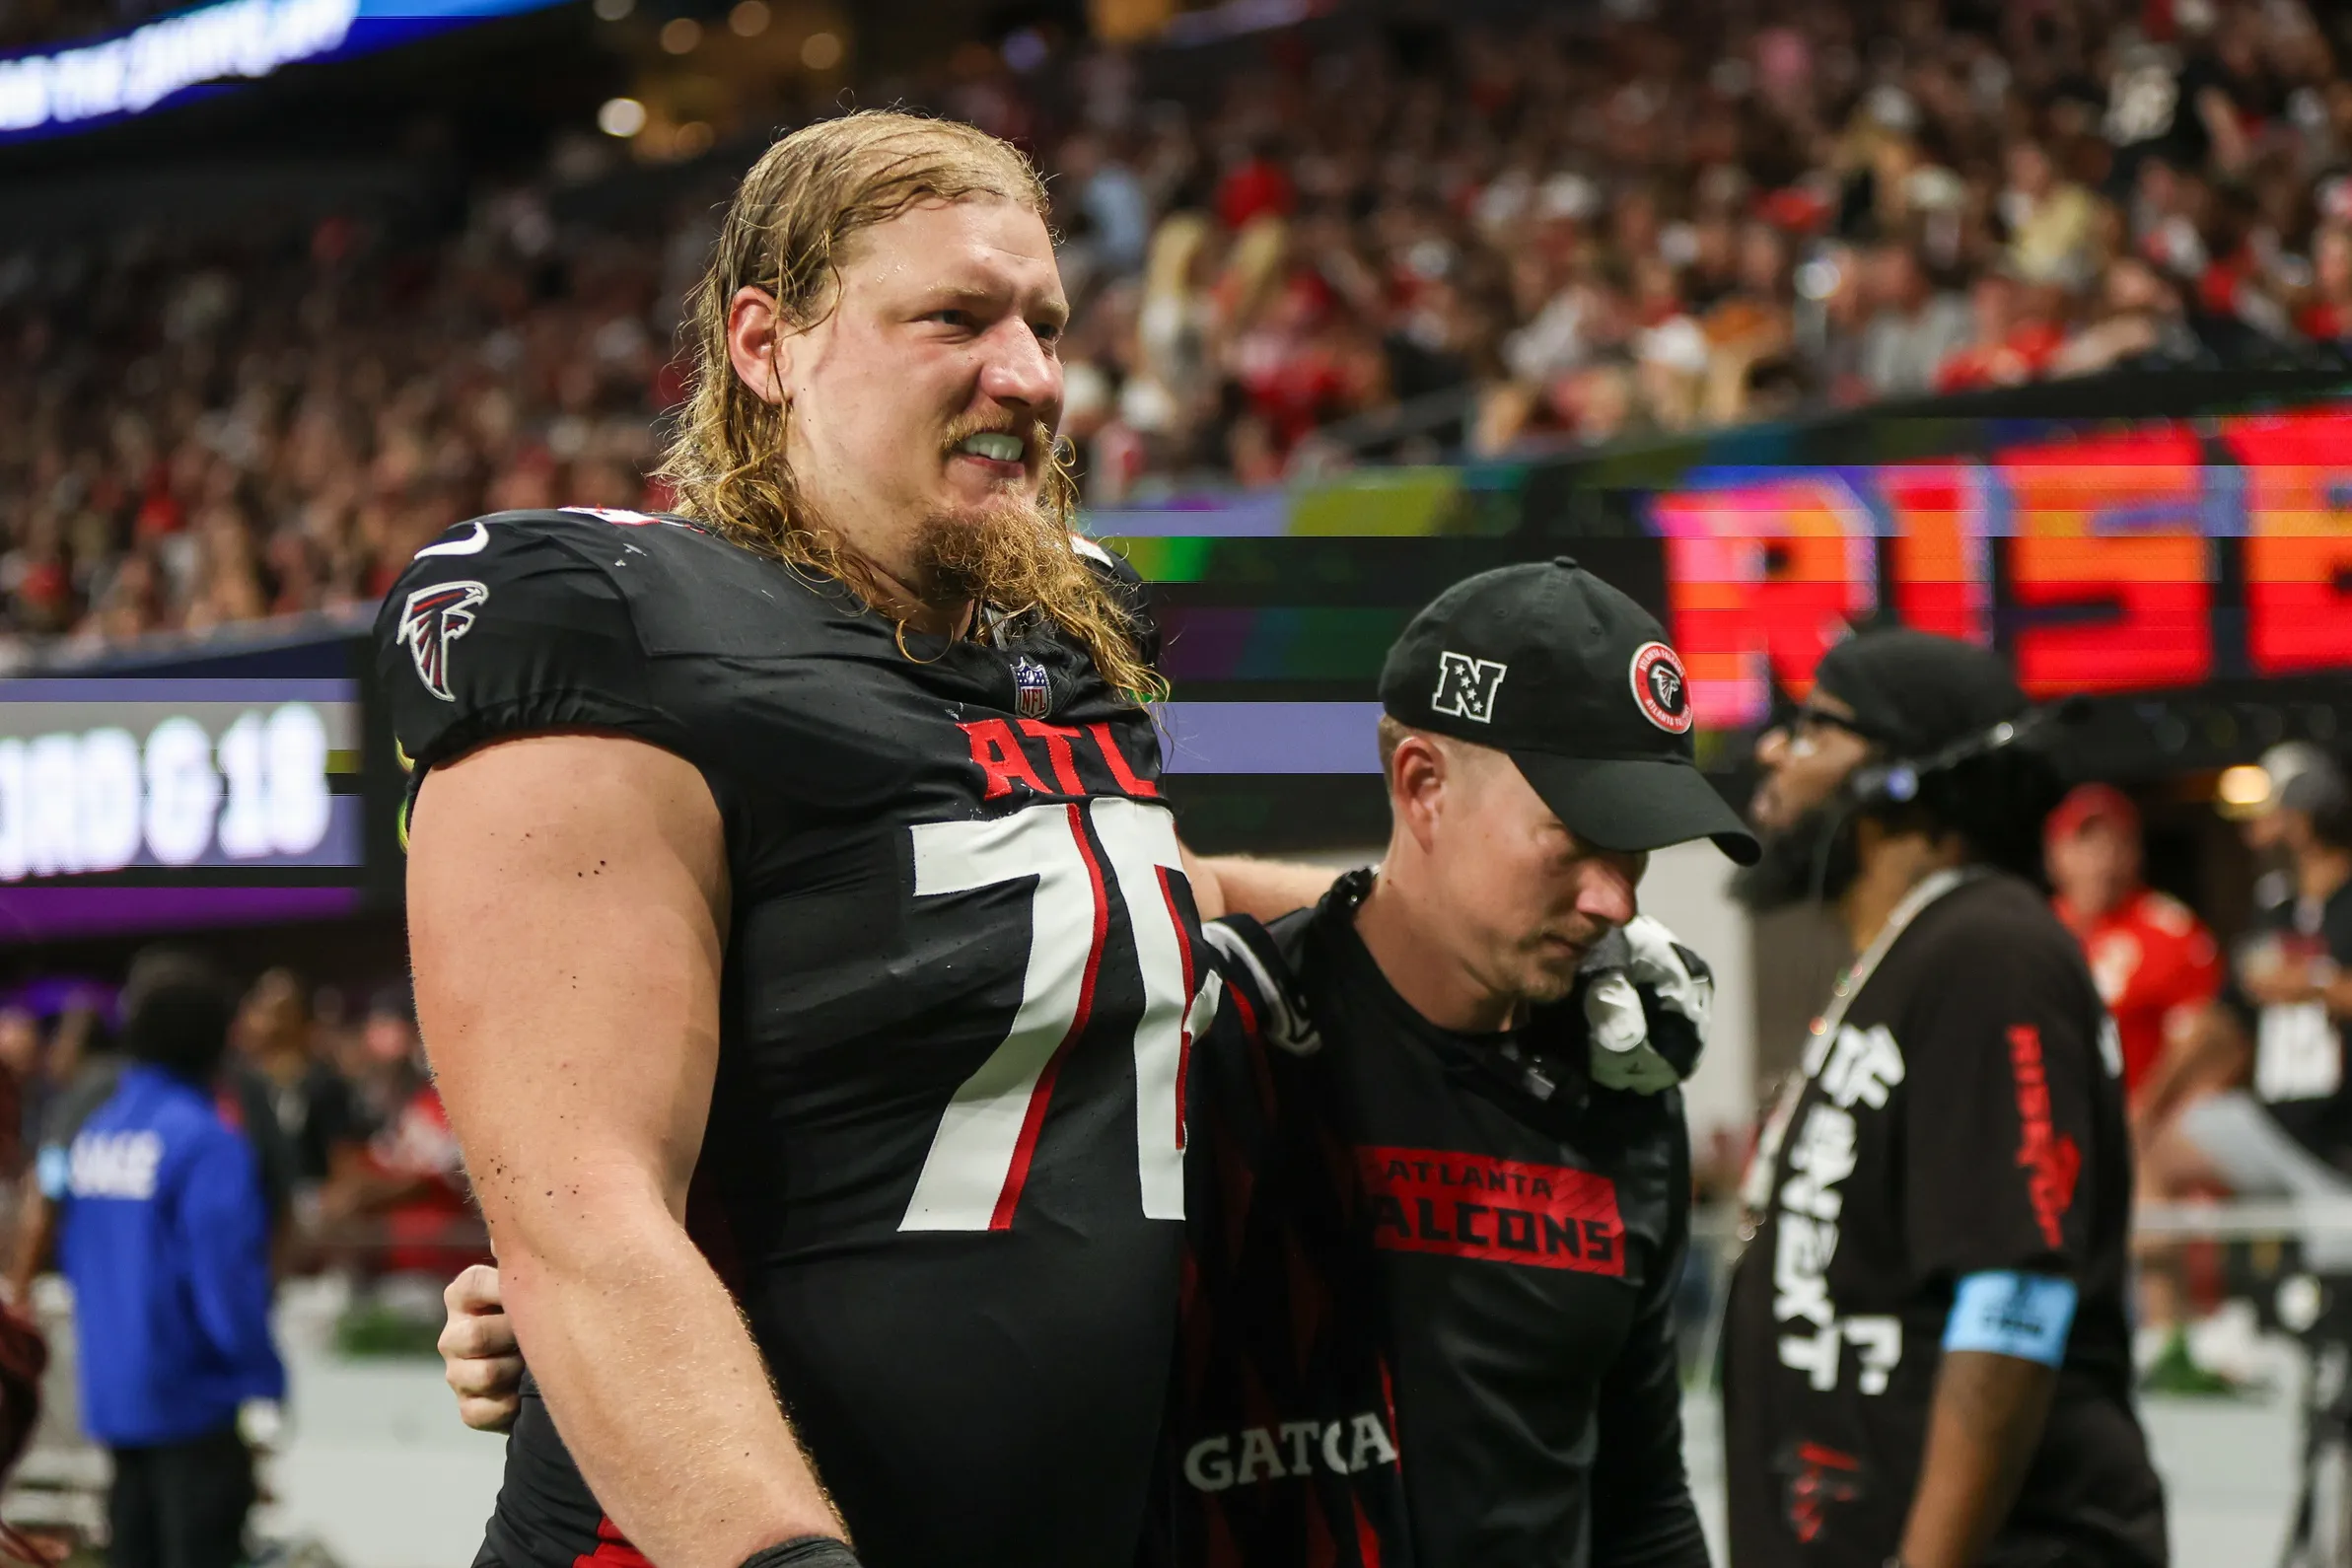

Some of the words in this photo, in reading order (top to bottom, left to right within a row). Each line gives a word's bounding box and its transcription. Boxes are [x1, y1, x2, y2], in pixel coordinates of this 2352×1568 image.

[1021, 687, 1046, 714] NFL
[956, 718, 1159, 800] ATL
[1386, 1160, 1553, 1200] ATLANTA
[1374, 1195, 1613, 1261] ALCONS
